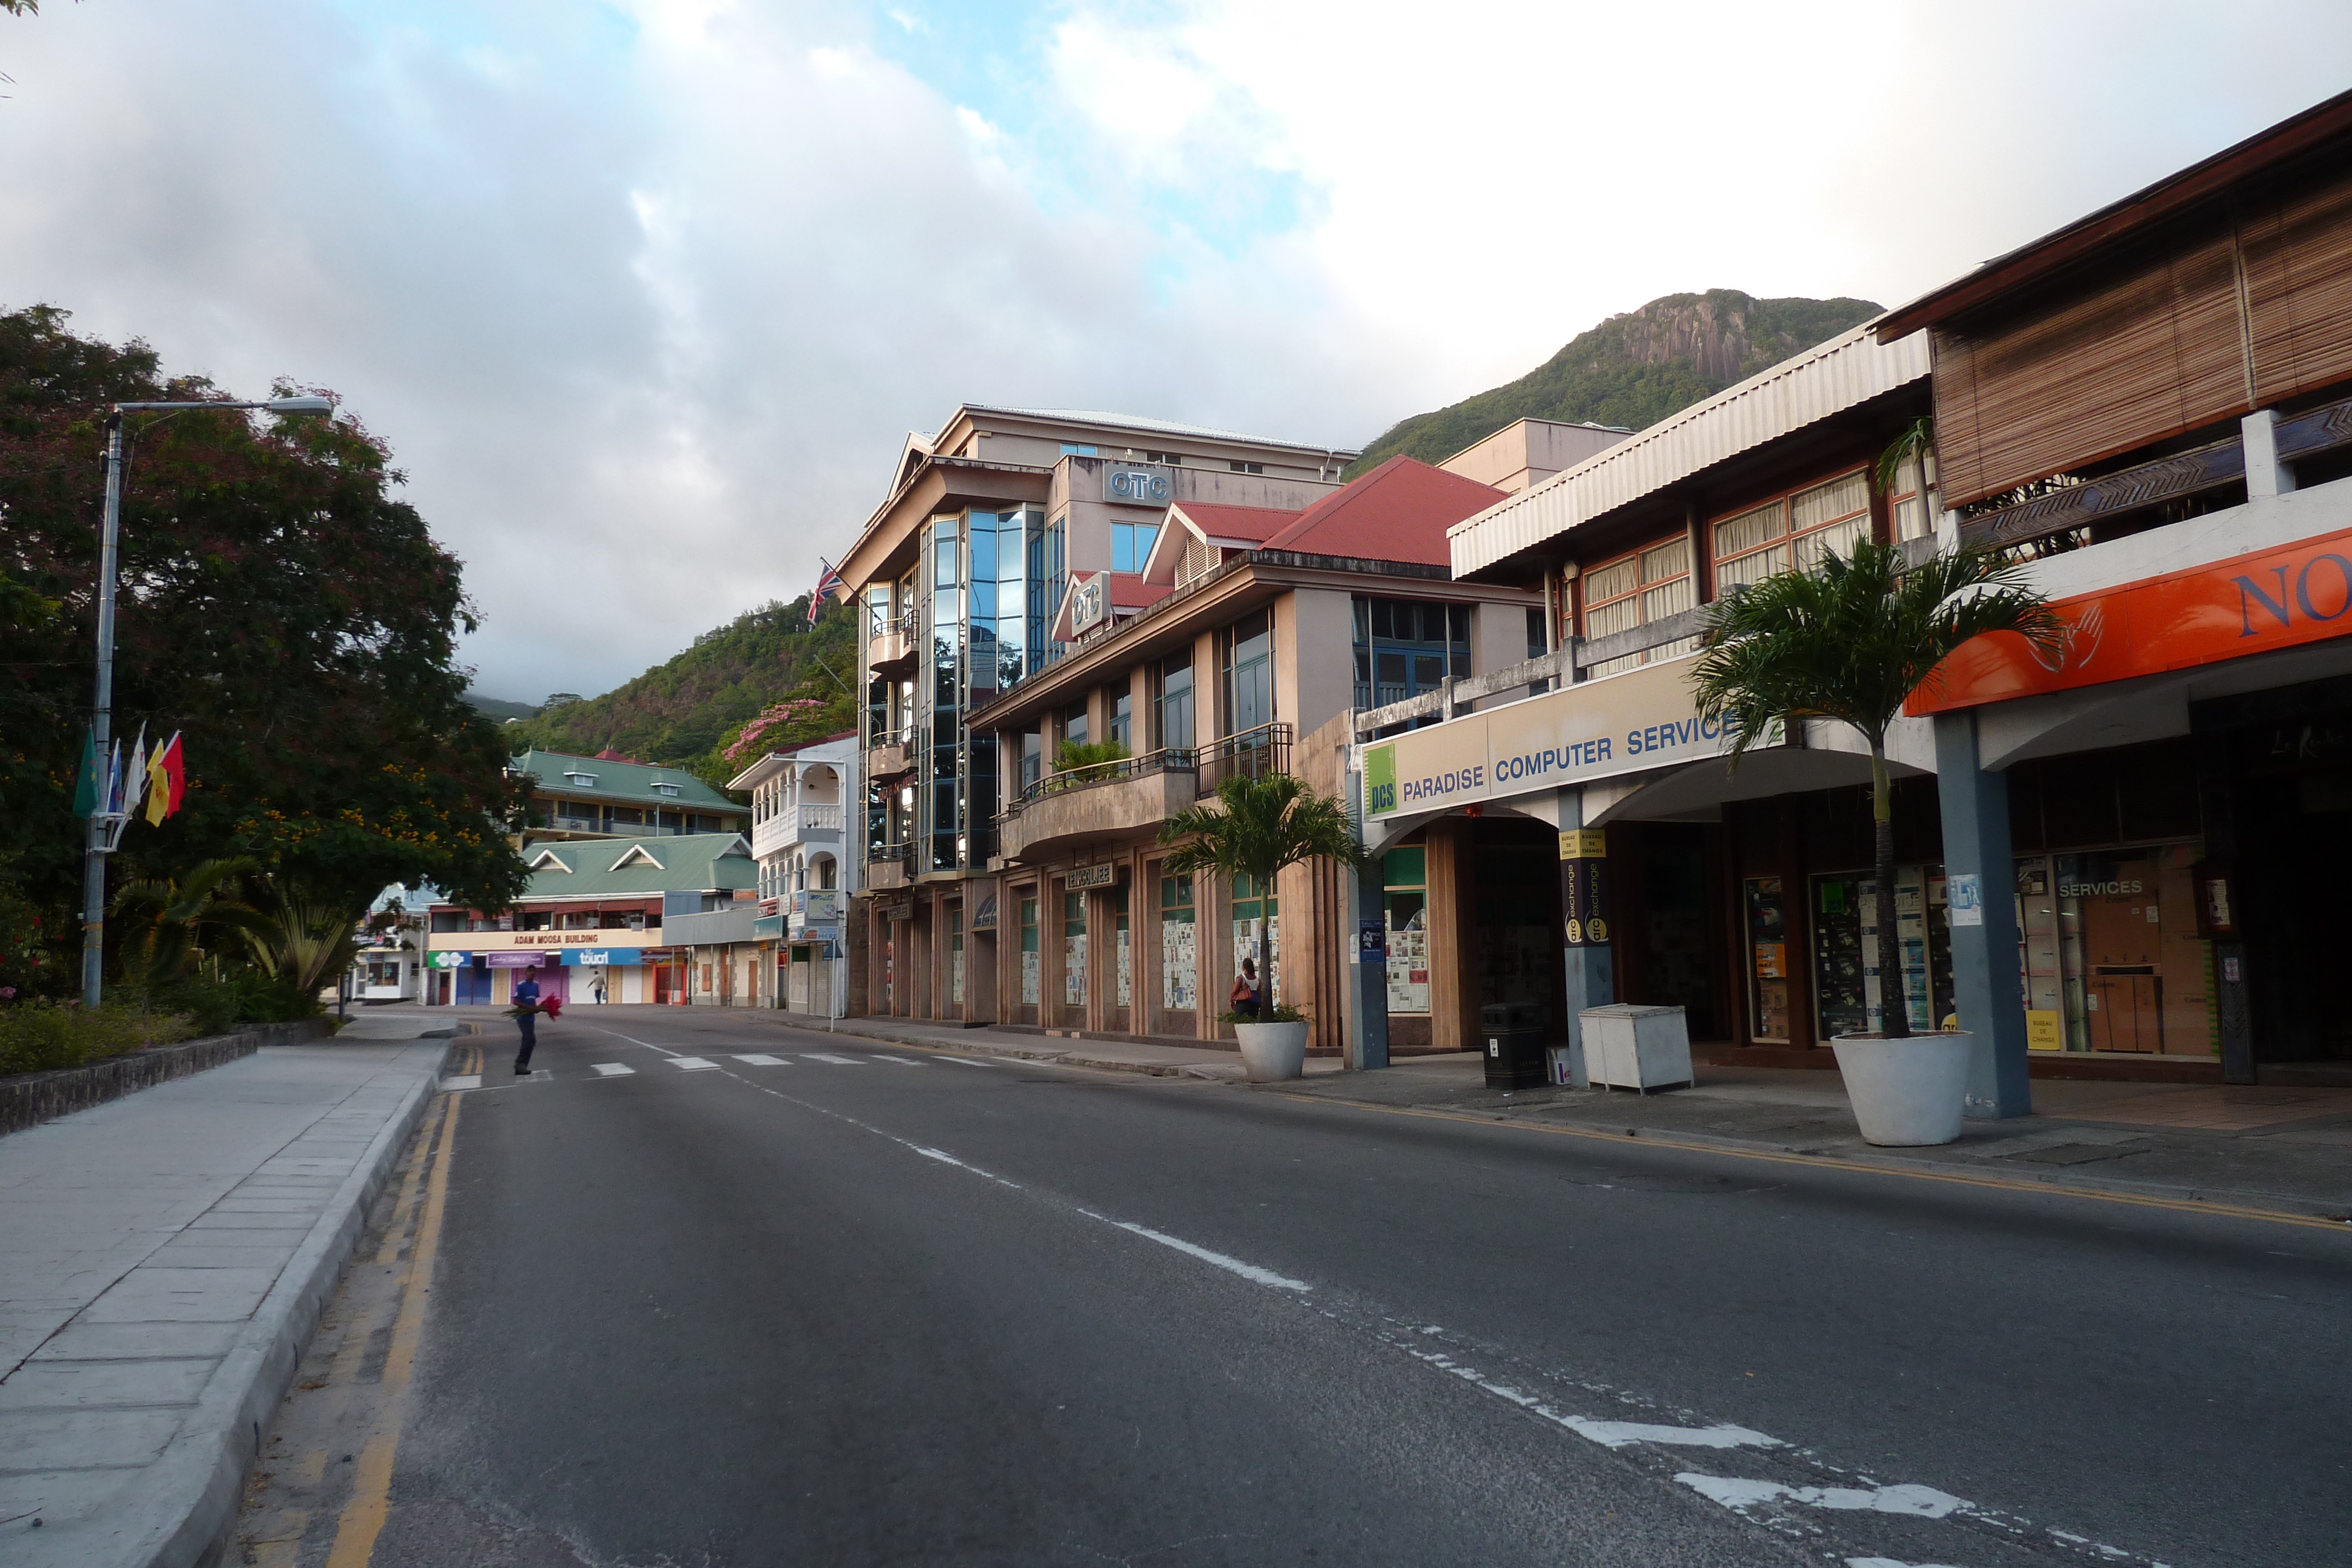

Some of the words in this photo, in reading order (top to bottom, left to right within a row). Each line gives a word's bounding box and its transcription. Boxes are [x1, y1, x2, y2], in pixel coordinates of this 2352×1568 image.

[1110, 472, 1167, 500] OTC
[1073, 583, 1100, 625] OTC
[2230, 554, 2352, 638] NO
[1404, 765, 1484, 802] PARADISE
[1496, 737, 1612, 782] COMPUTER
[1627, 707, 1748, 755] SERVICE
[1372, 783, 1394, 814] pcs
[1568, 864, 1576, 918] exchange
[1590, 862, 1599, 917] exchange
[2059, 880, 2143, 898] SERVICES
[514, 935, 534, 944] ADAM
[537, 935, 562, 944] MOOSA
[565, 934, 598, 943] BUILDING
[1592, 920, 1601, 941] arc
